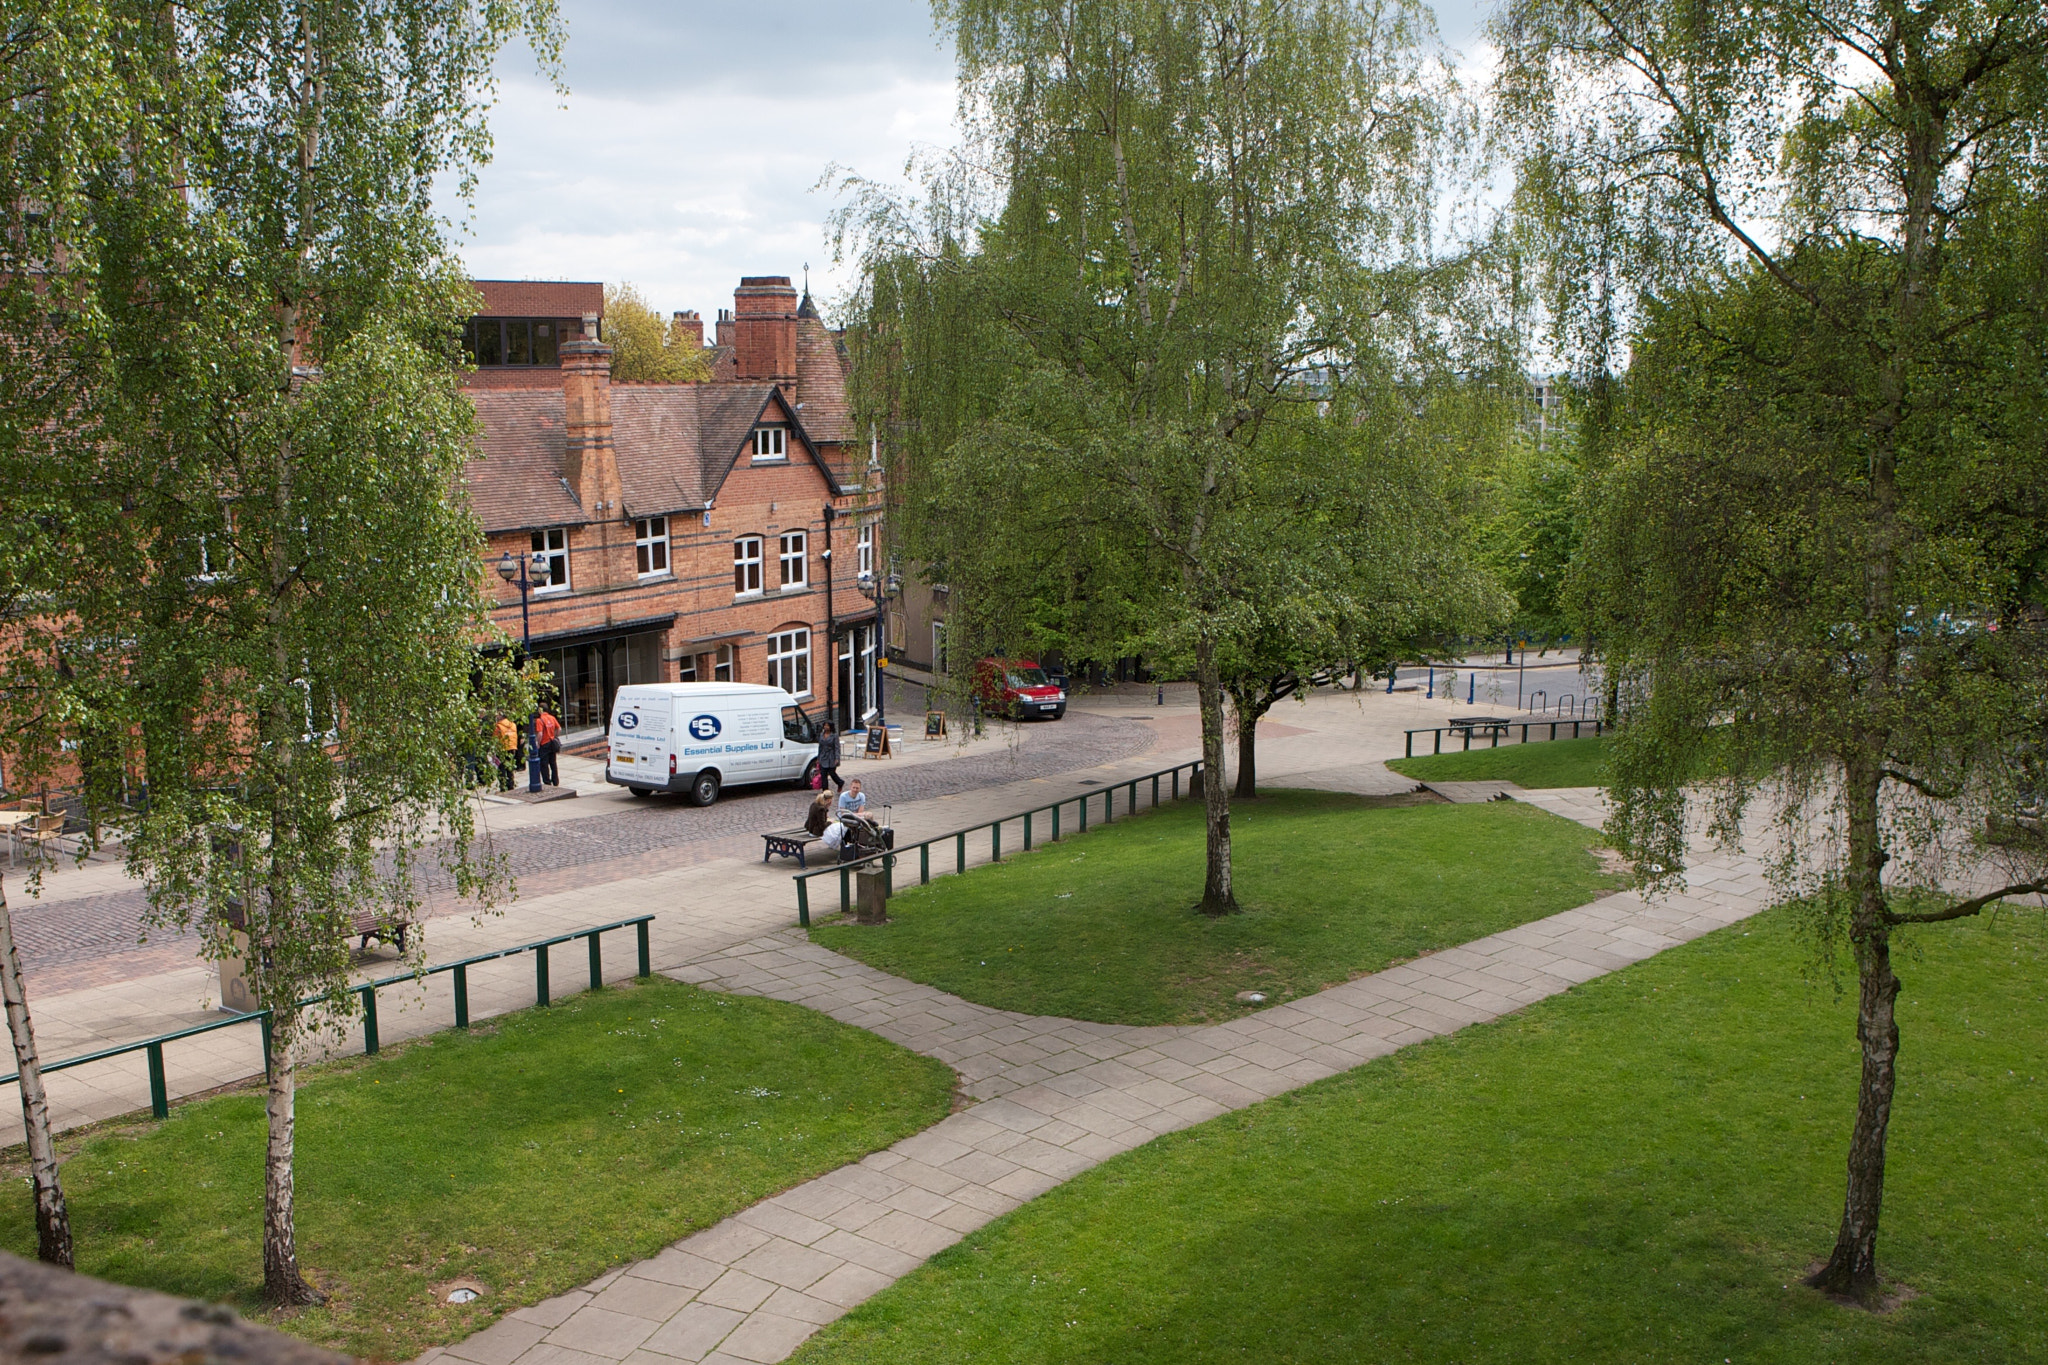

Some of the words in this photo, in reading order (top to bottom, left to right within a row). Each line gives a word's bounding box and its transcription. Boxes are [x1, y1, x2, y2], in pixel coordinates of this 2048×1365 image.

[692, 718, 719, 737] ESL
[684, 746, 722, 756] Essential
[725, 743, 758, 753] Supplies
[761, 741, 774, 750] Ltd
